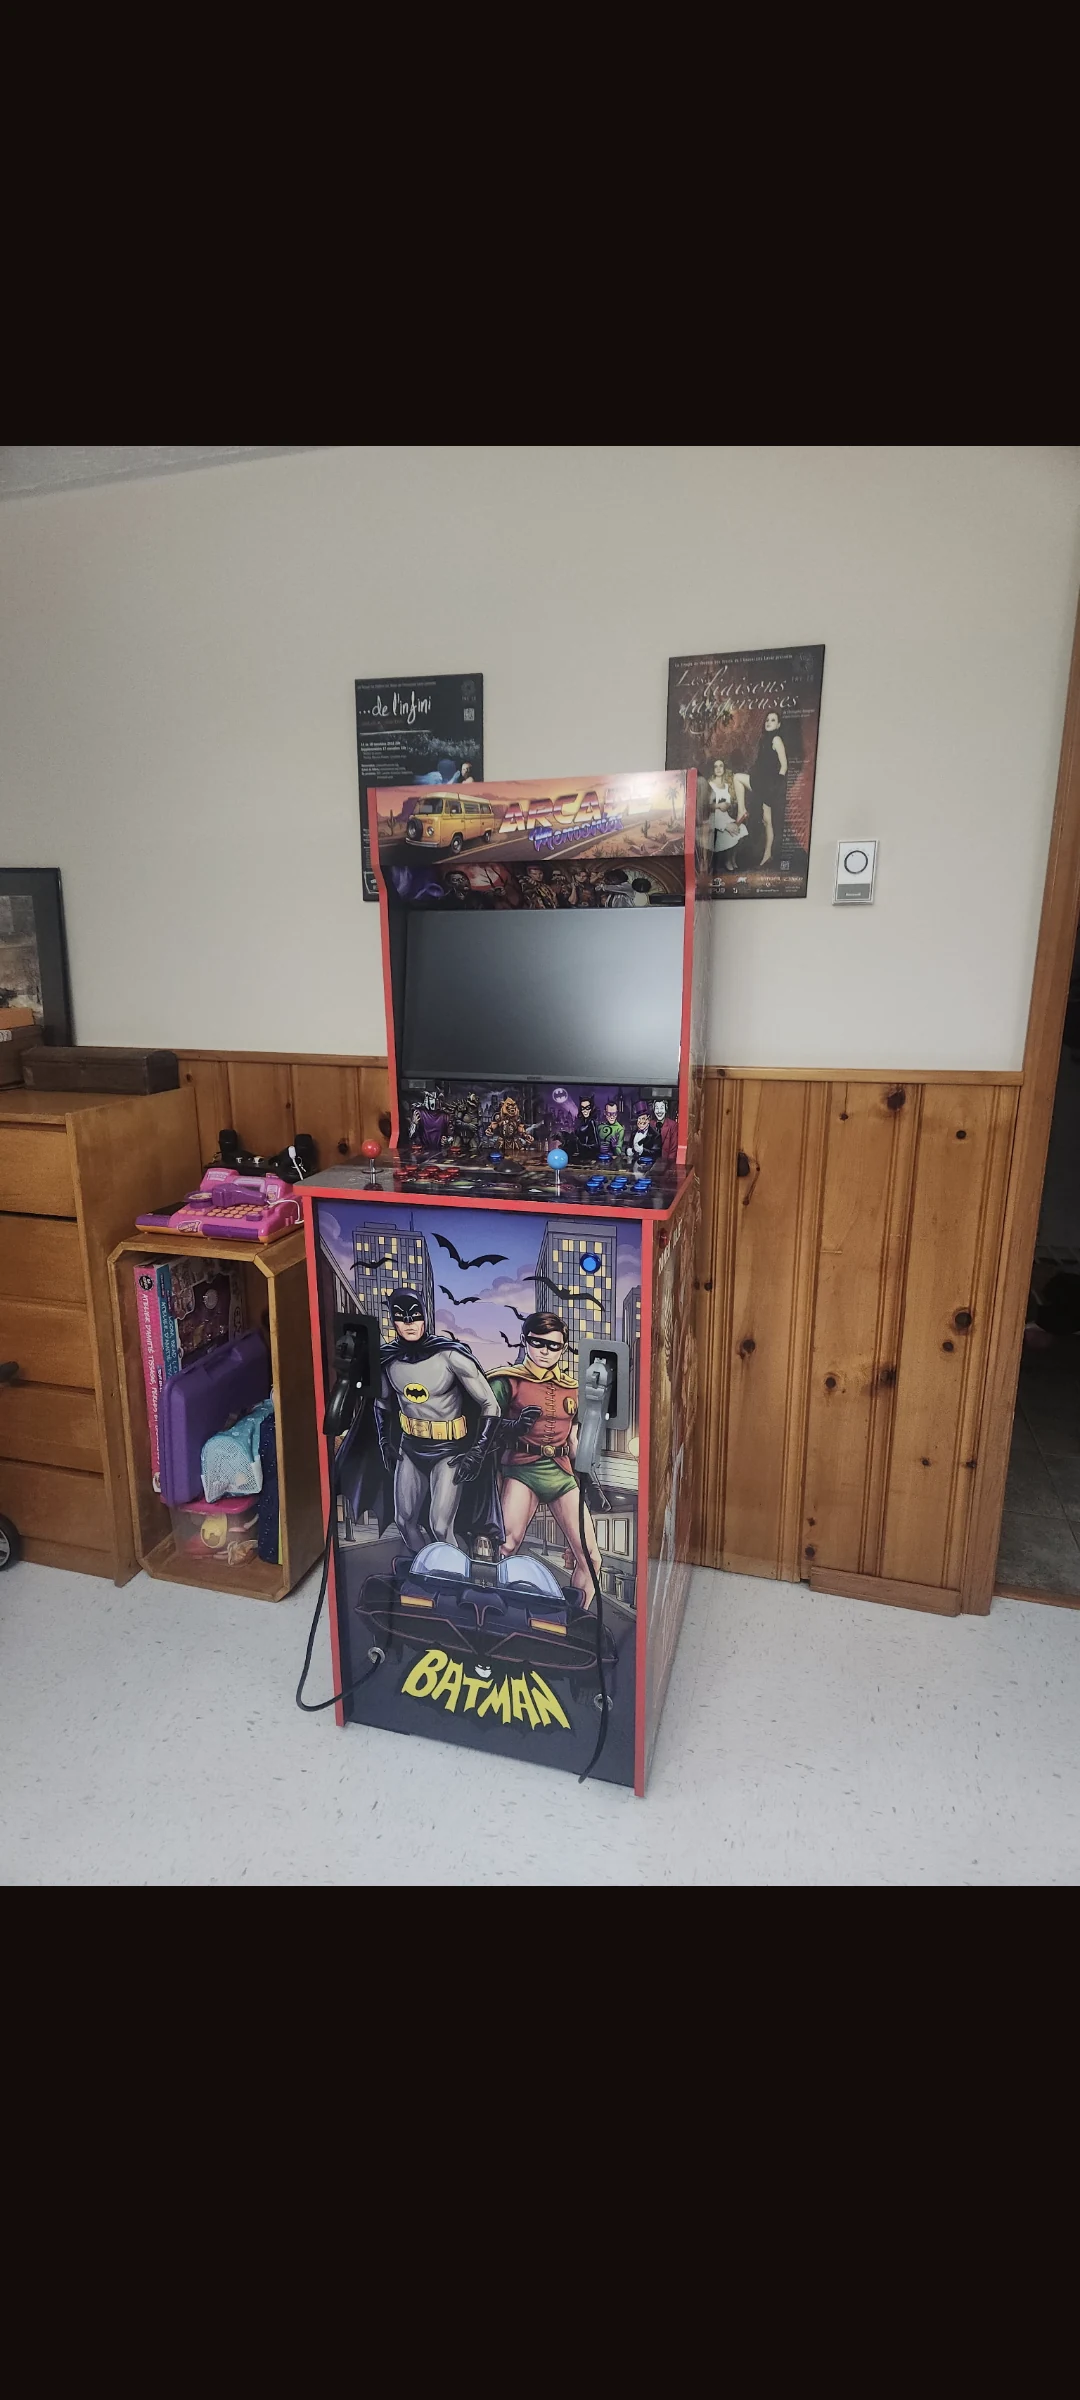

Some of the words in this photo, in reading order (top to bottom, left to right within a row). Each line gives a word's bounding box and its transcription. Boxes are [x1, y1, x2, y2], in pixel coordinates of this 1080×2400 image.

[675, 670, 705, 686] Les
[392, 690, 432, 725] l'infini
[679, 692, 799, 719] dangereuses
[499, 780, 655, 833] ARCADE
[142, 1293, 150, 1323] ATELIER
[567, 1397, 575, 1414] R
[401, 1649, 571, 1730] BATMAN
